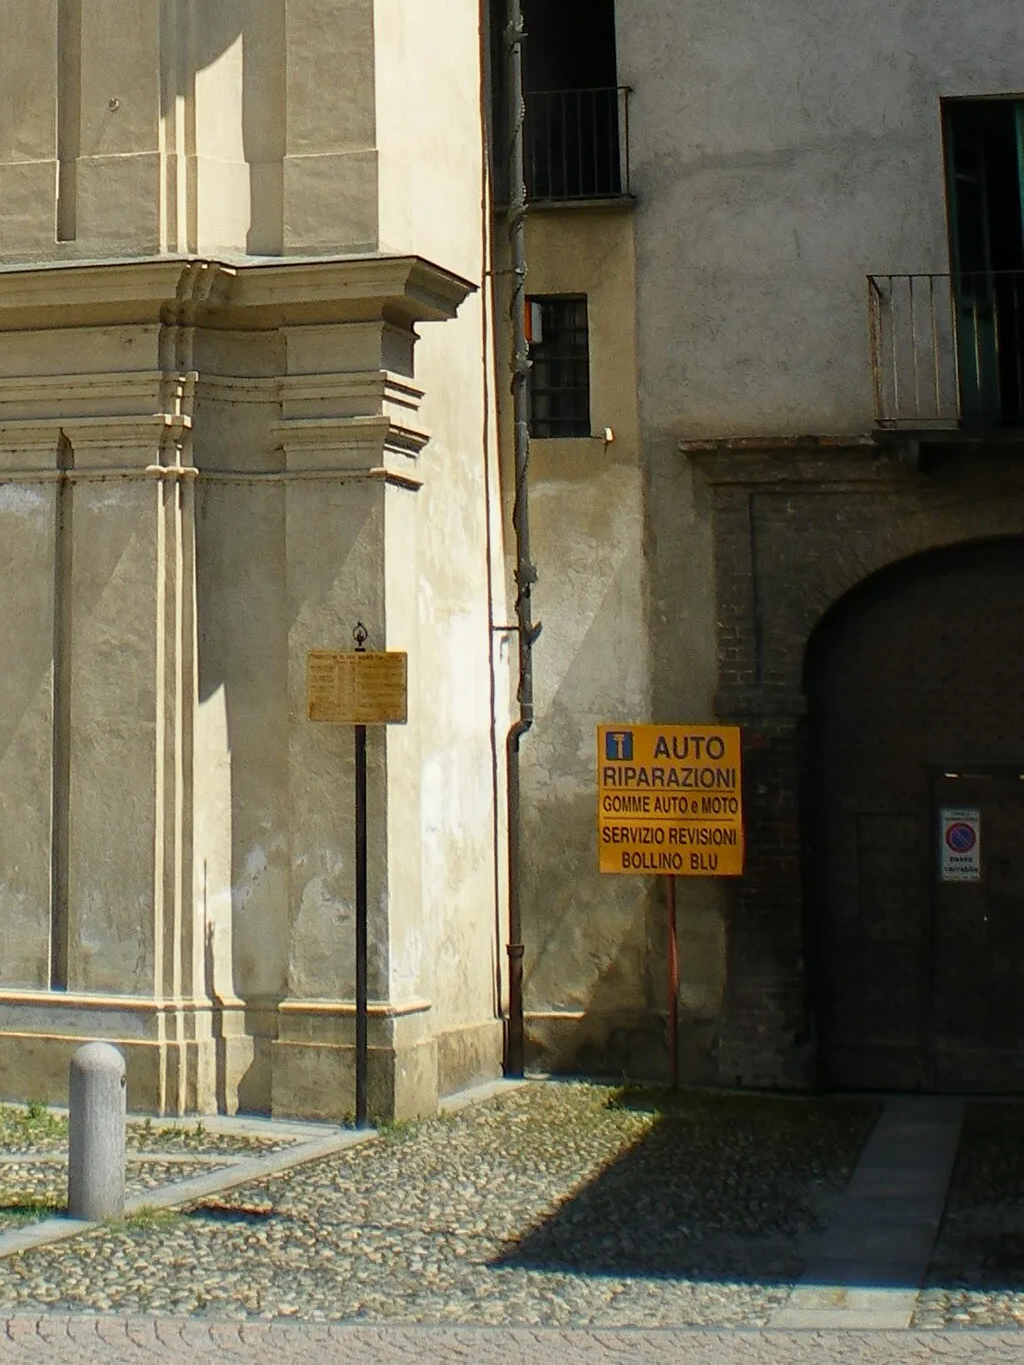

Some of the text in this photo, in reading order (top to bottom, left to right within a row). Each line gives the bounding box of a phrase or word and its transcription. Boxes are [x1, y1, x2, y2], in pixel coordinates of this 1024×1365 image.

[653, 735, 725, 760] AUTO
[603, 766, 736, 788] RIPARAZIONI
[603, 794, 738, 814] GOMME AUTO e MOTO
[602, 826, 736, 846] SERVIZIO REVISIONI
[622, 851, 718, 871] BOLLINO BLU
